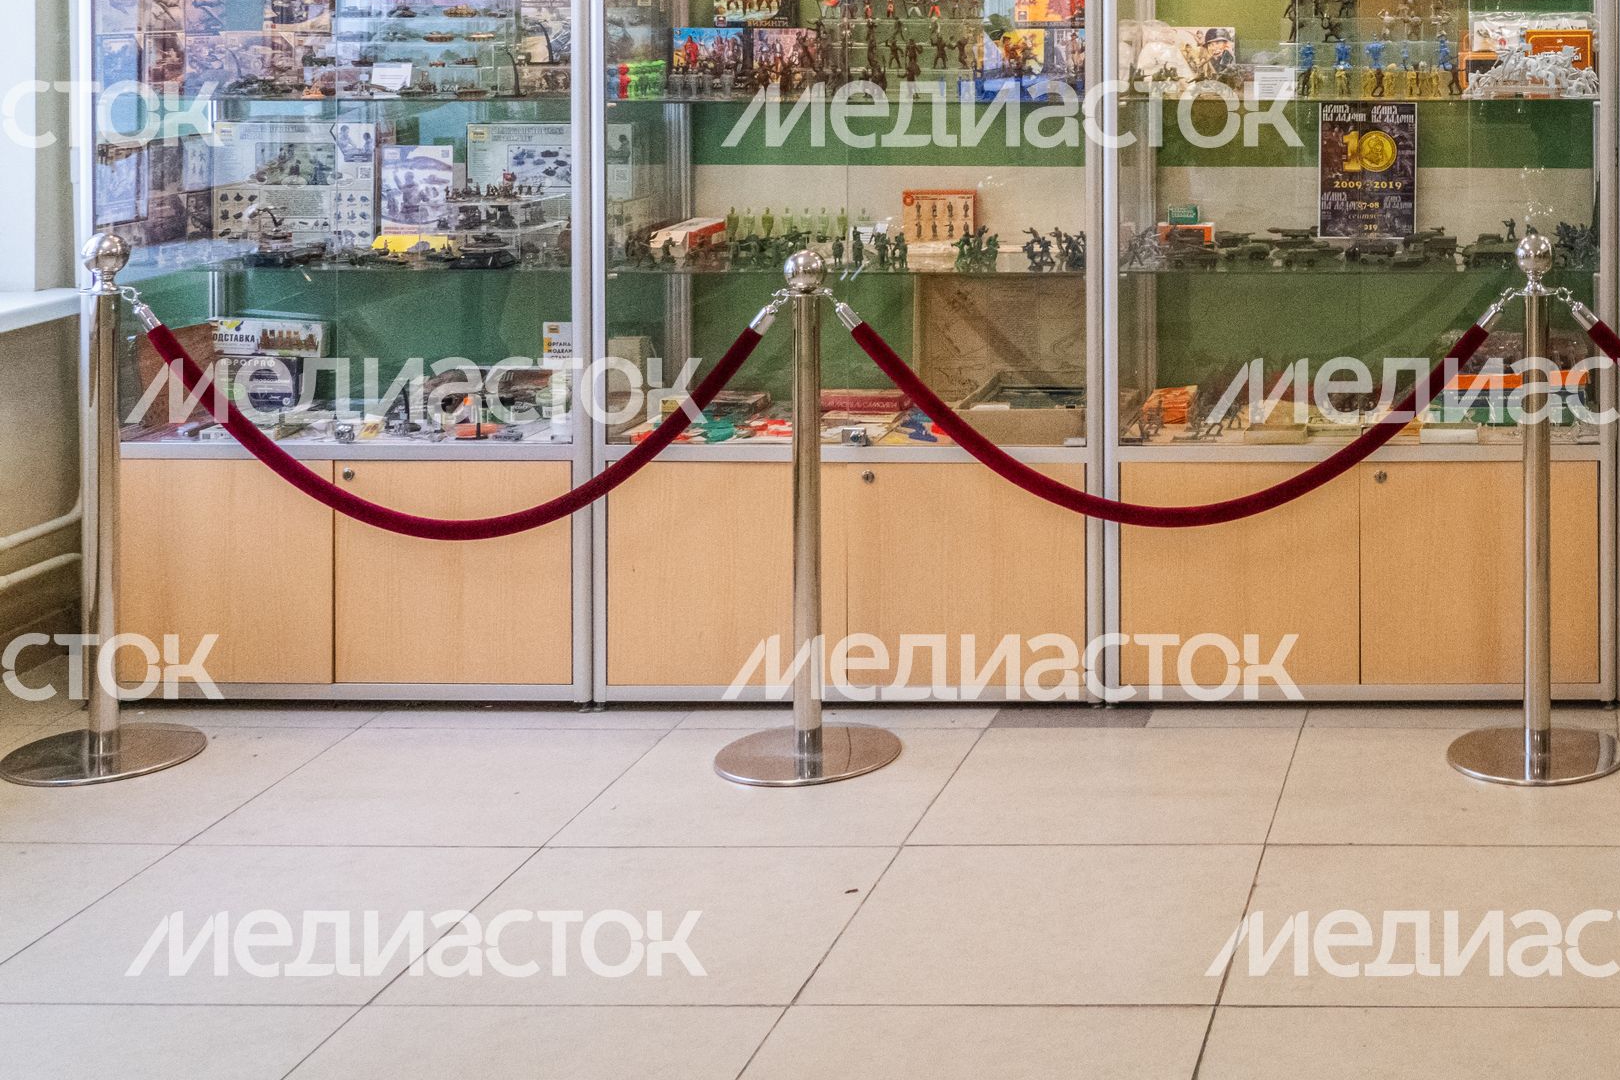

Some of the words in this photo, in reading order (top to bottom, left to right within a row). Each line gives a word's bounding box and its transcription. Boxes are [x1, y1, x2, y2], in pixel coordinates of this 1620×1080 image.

[1333, 181, 1362, 189] 2009
[1373, 181, 1402, 189] 2019
[212, 333, 256, 343] ОДСТАВКА
